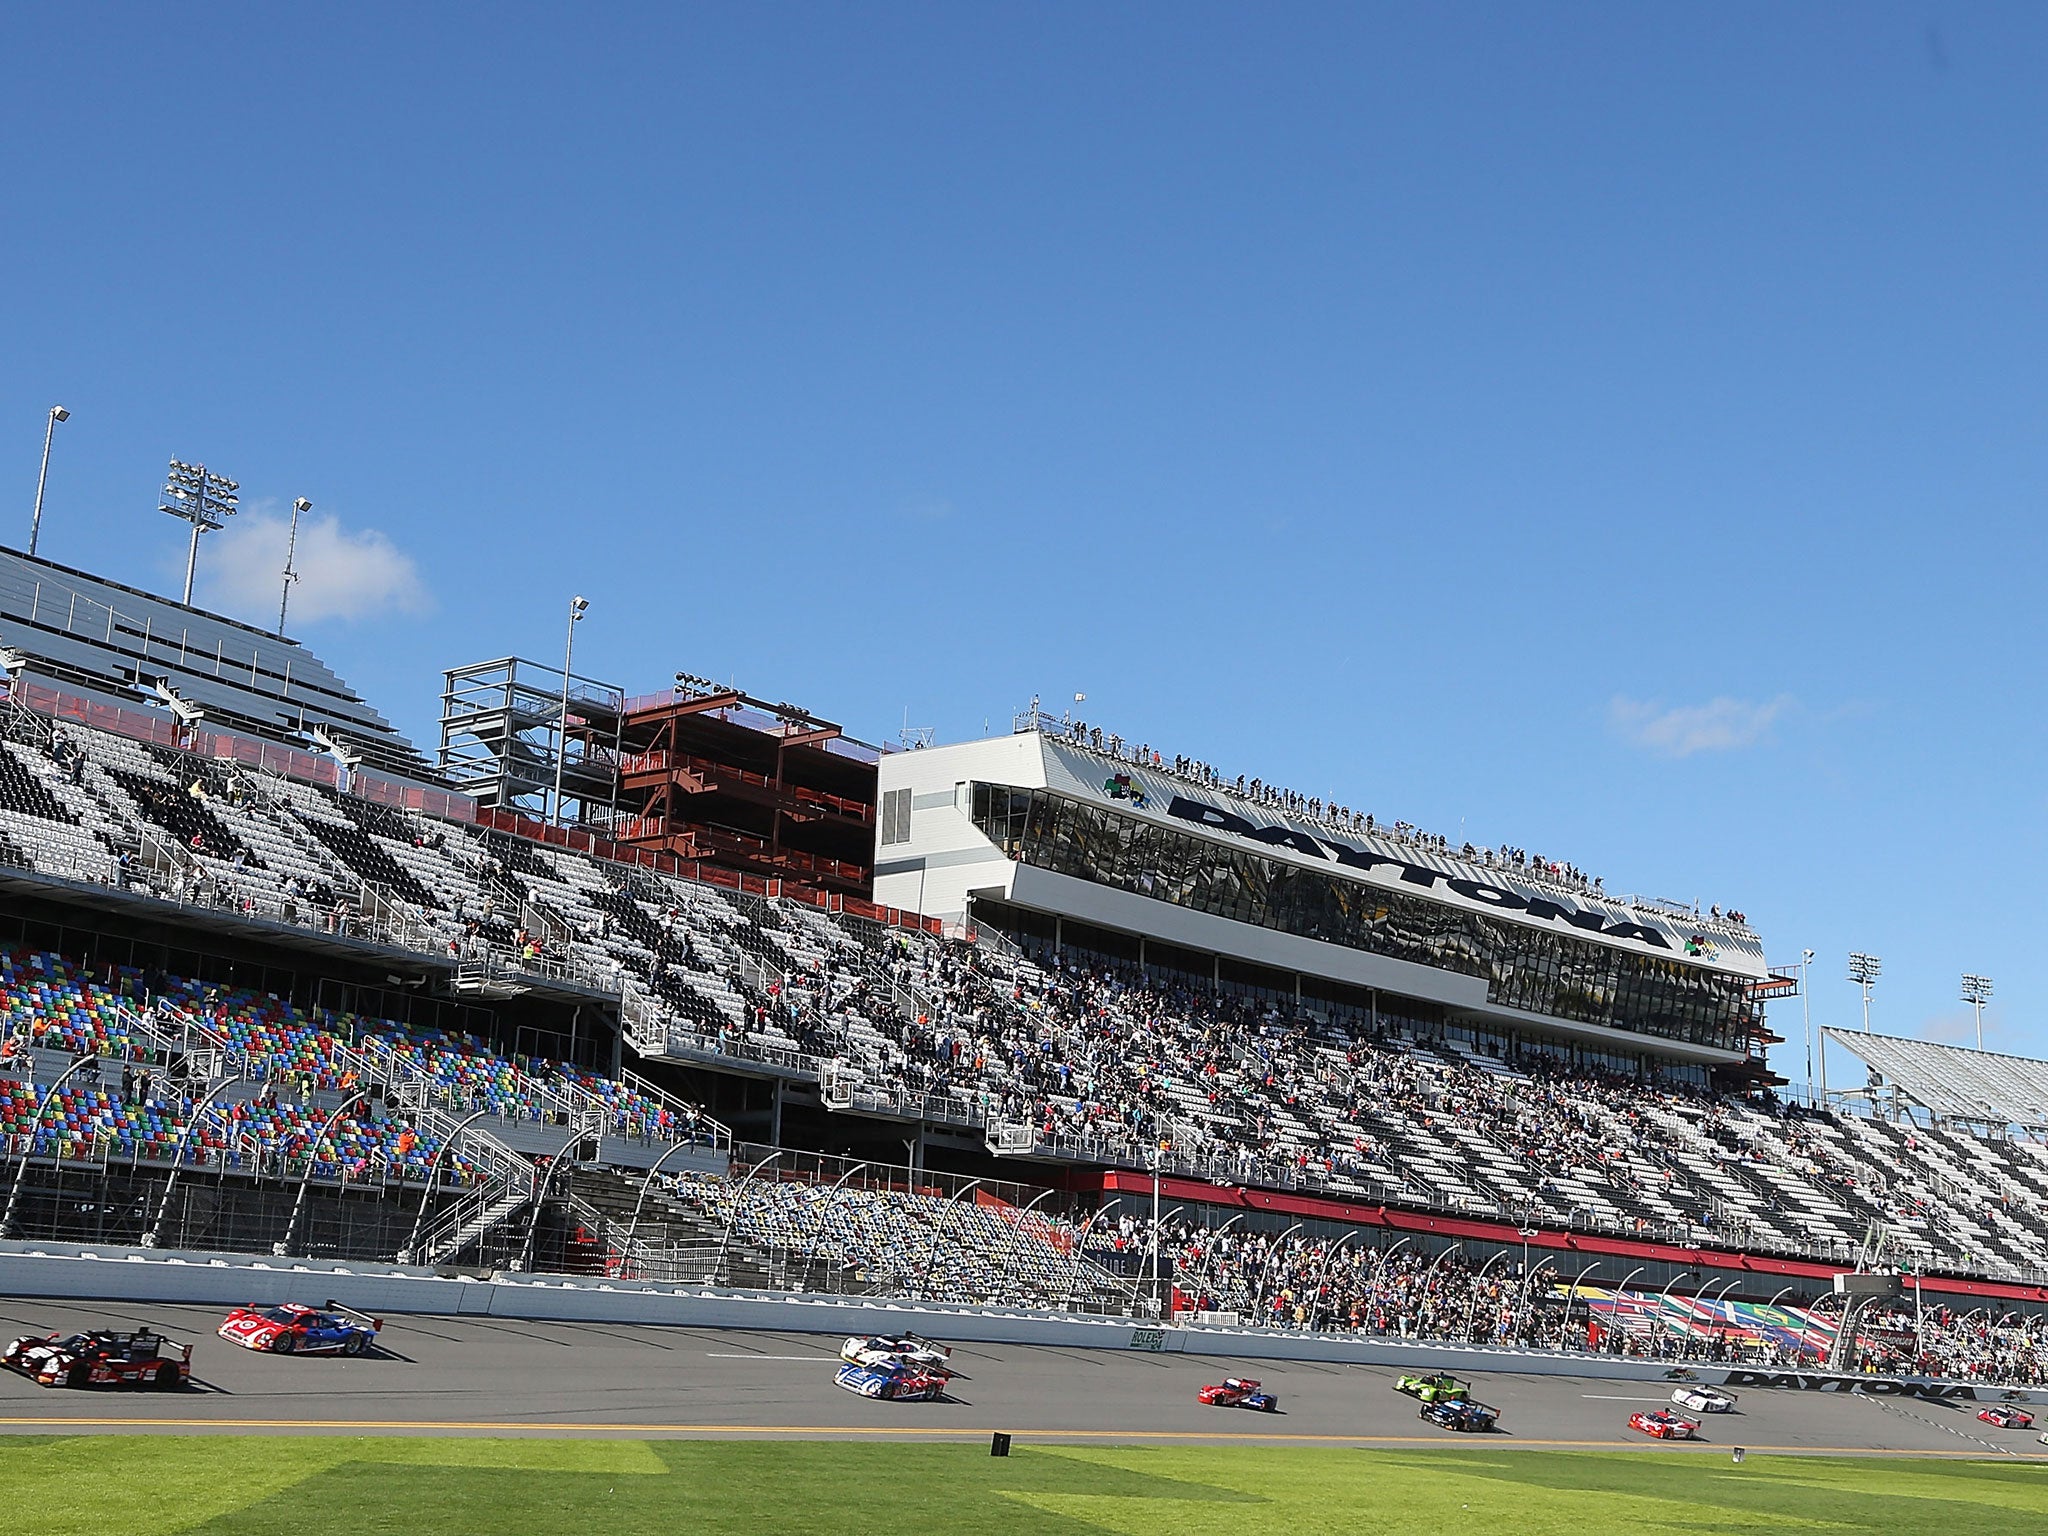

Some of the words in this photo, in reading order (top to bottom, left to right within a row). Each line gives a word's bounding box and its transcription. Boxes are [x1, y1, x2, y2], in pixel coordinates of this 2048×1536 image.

[1168, 796, 1673, 949] DAYTONA
[1131, 1330, 1157, 1343] ROLEX
[1724, 1371, 1977, 1400] DAYTONA
